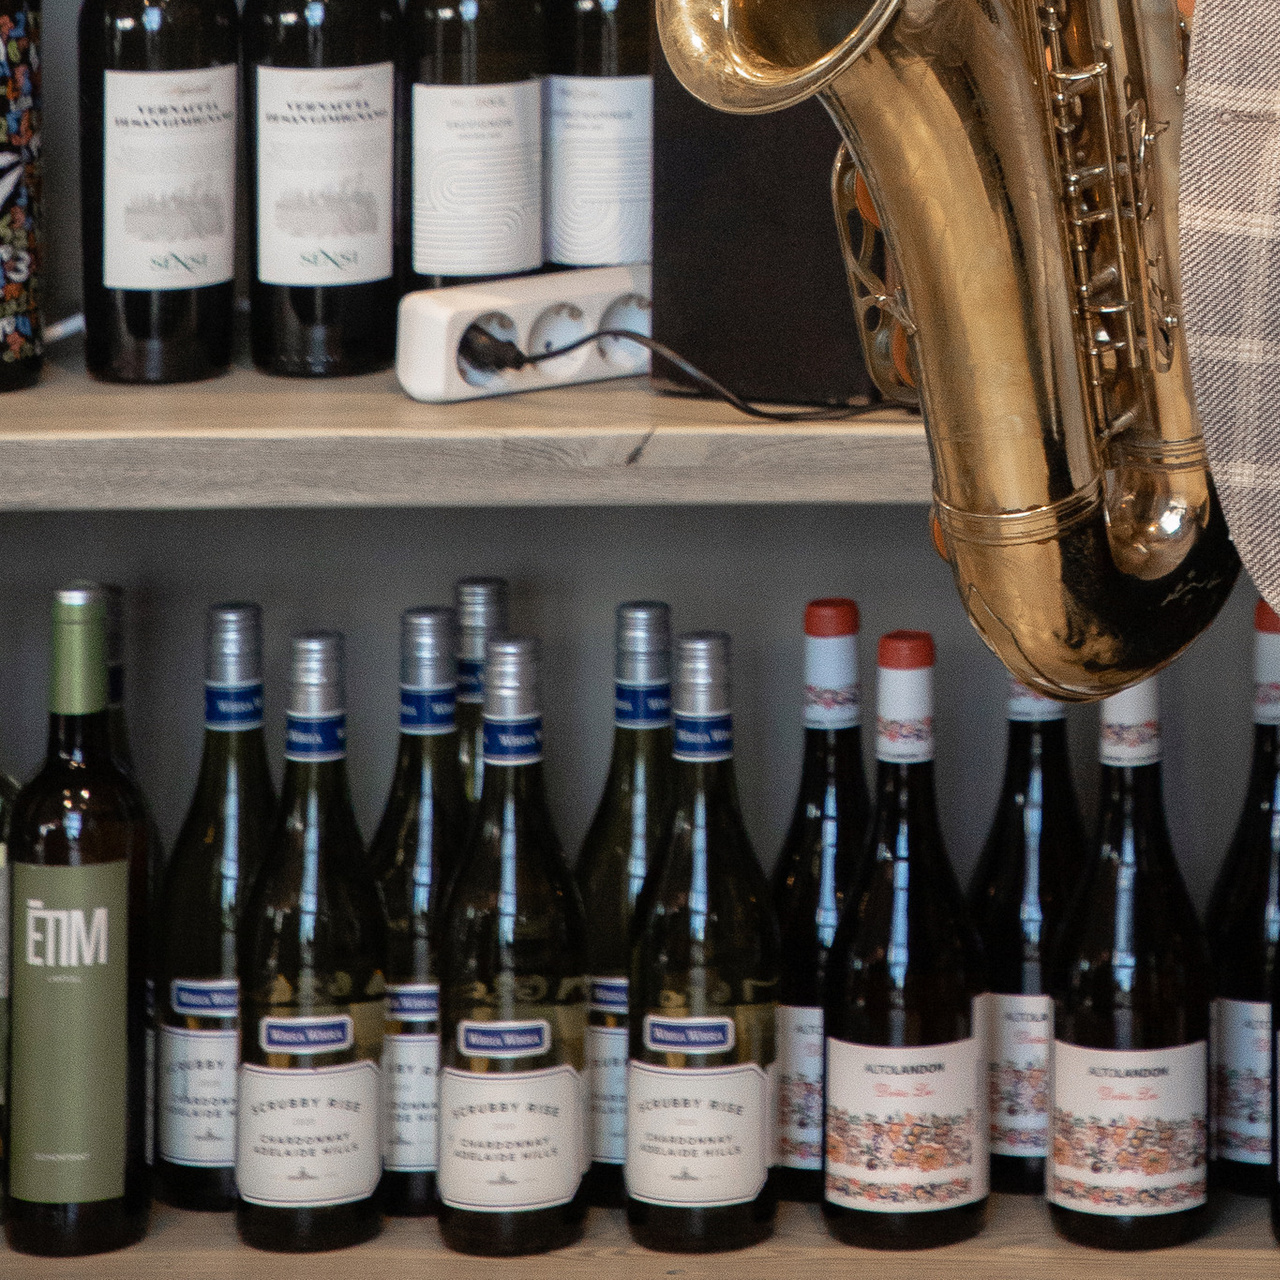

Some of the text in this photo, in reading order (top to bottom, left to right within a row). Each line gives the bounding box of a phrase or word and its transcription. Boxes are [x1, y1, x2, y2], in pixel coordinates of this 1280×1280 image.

[328, 1098, 361, 1112] RISE
[527, 1103, 559, 1117] RISE
[709, 1100, 744, 1115] RISE
